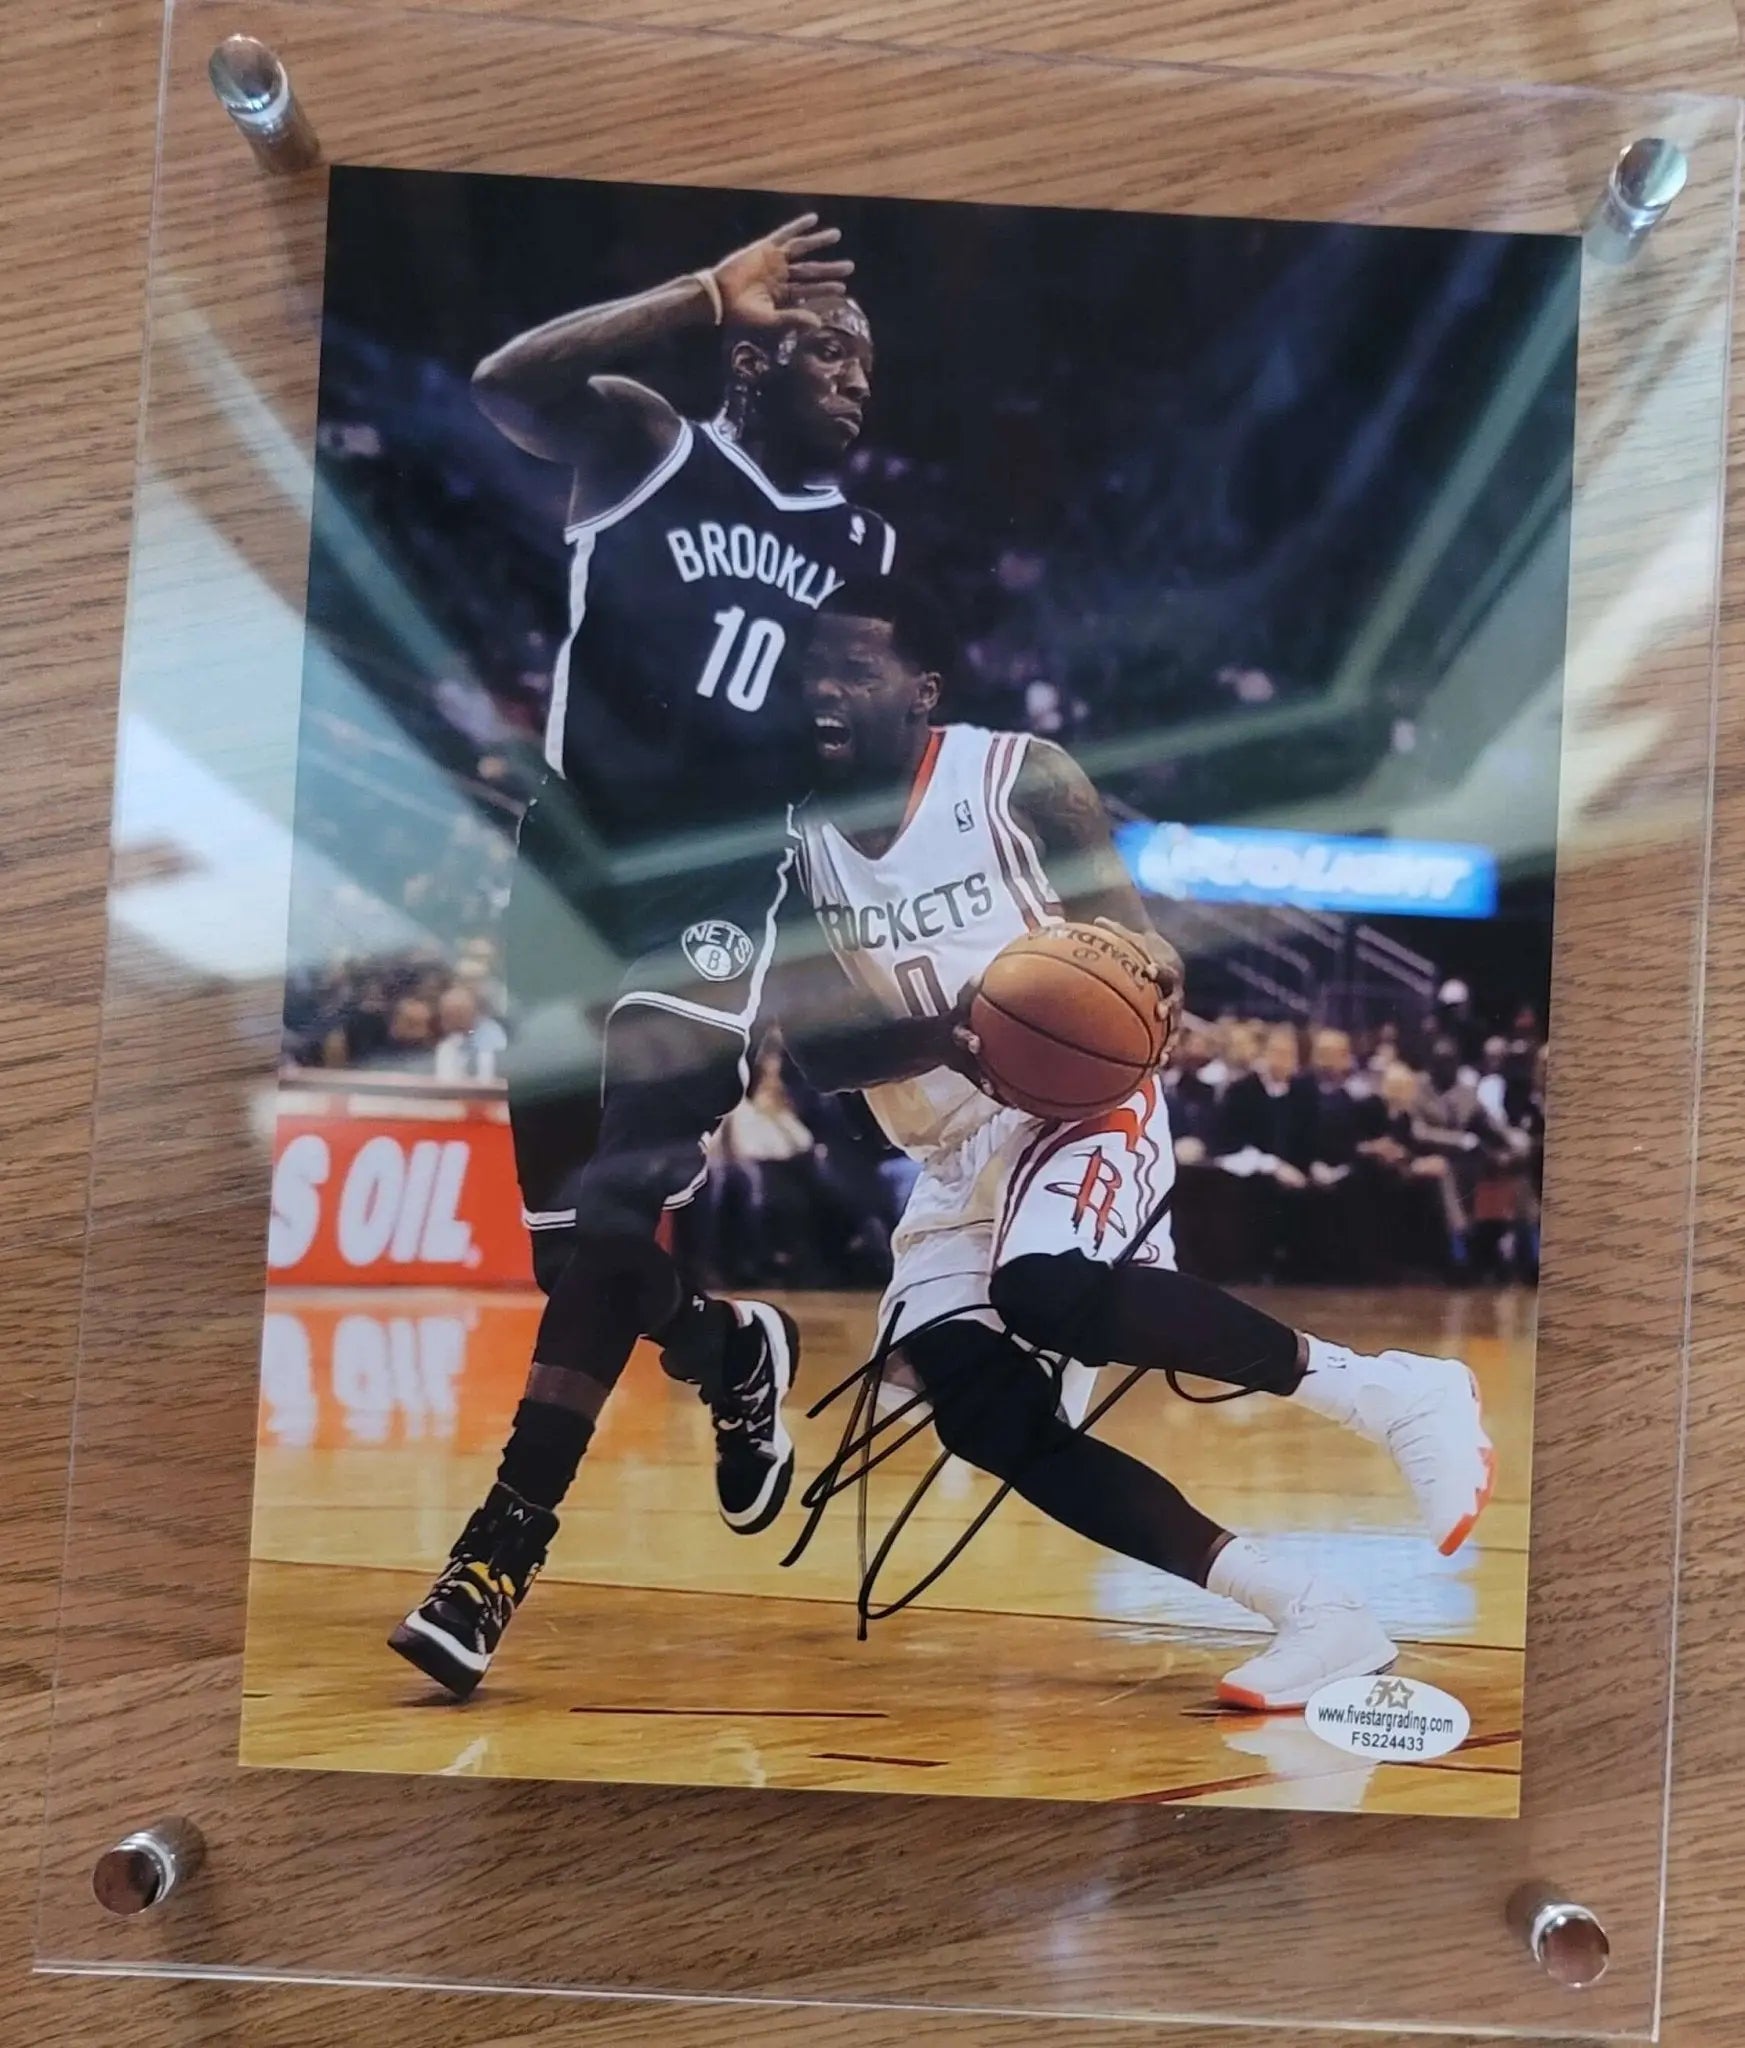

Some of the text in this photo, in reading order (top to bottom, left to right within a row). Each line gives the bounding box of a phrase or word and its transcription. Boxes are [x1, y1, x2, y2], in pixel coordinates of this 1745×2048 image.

[696, 605, 786, 712] 10
[686, 924, 751, 963] NETS
[268, 1134, 331, 1268] S
[1318, 1704, 1454, 1735] www.fivestargrading.com
[1351, 1731, 1424, 1752] FS224433
